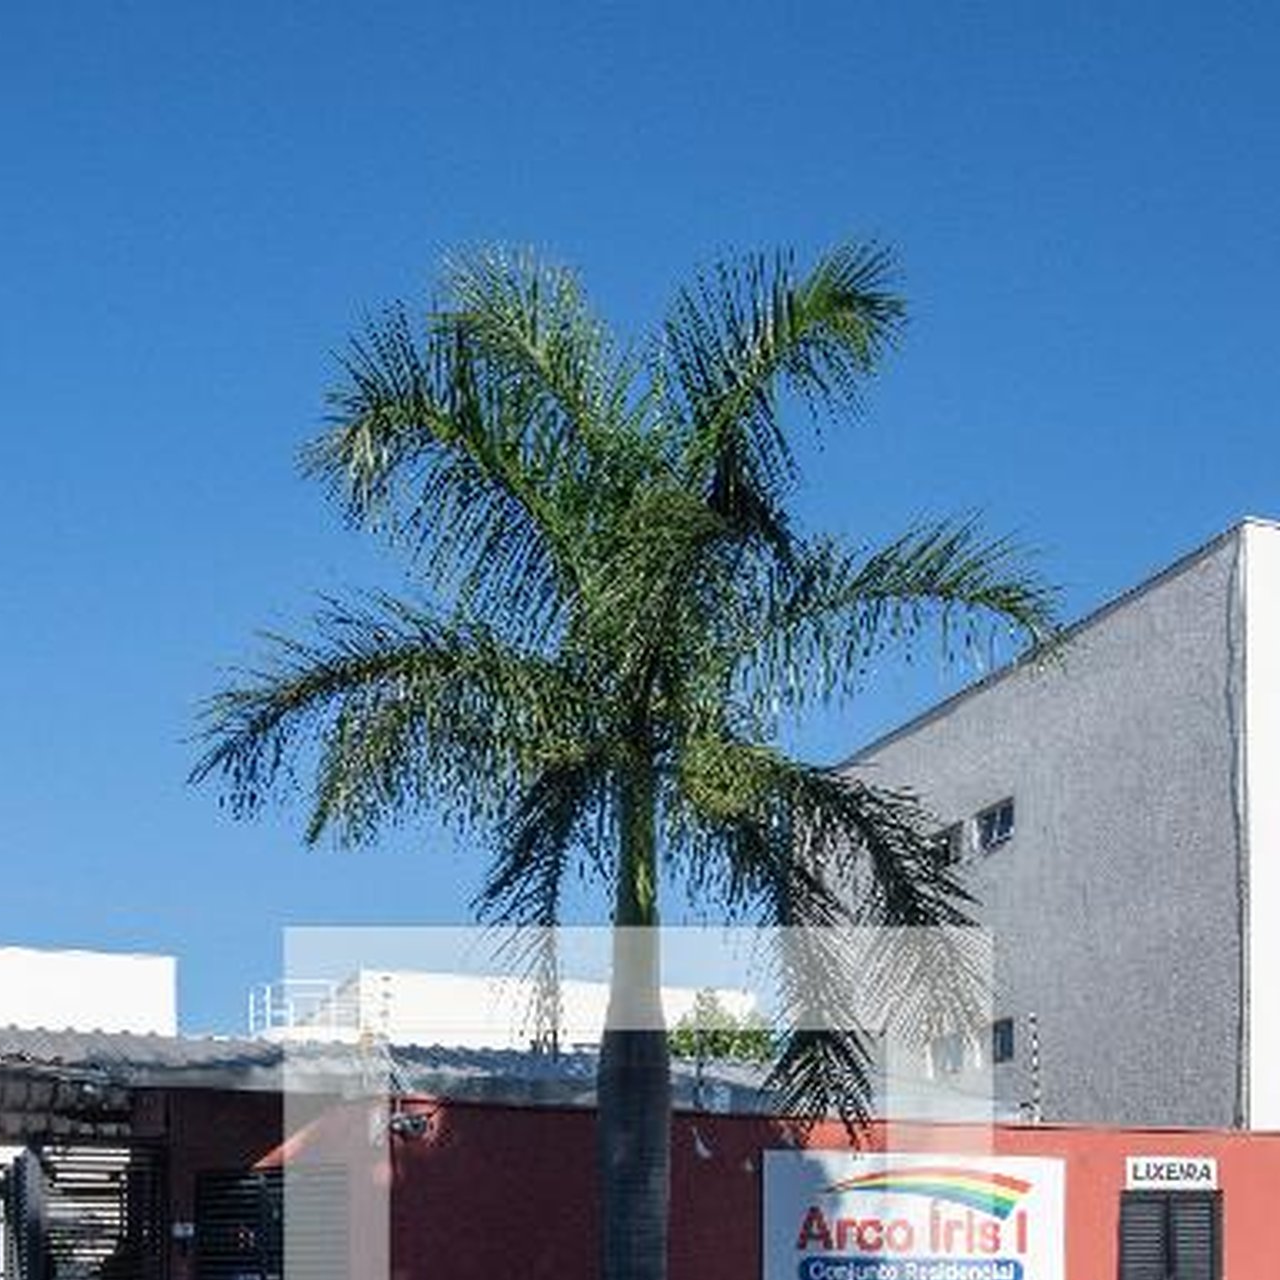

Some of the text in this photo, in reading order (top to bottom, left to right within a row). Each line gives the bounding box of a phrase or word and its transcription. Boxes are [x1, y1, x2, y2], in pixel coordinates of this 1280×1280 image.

[1132, 1162, 1212, 1181] LIXEIRA
[796, 1205, 915, 1253] Arco
[1016, 1209, 1028, 1254] I
